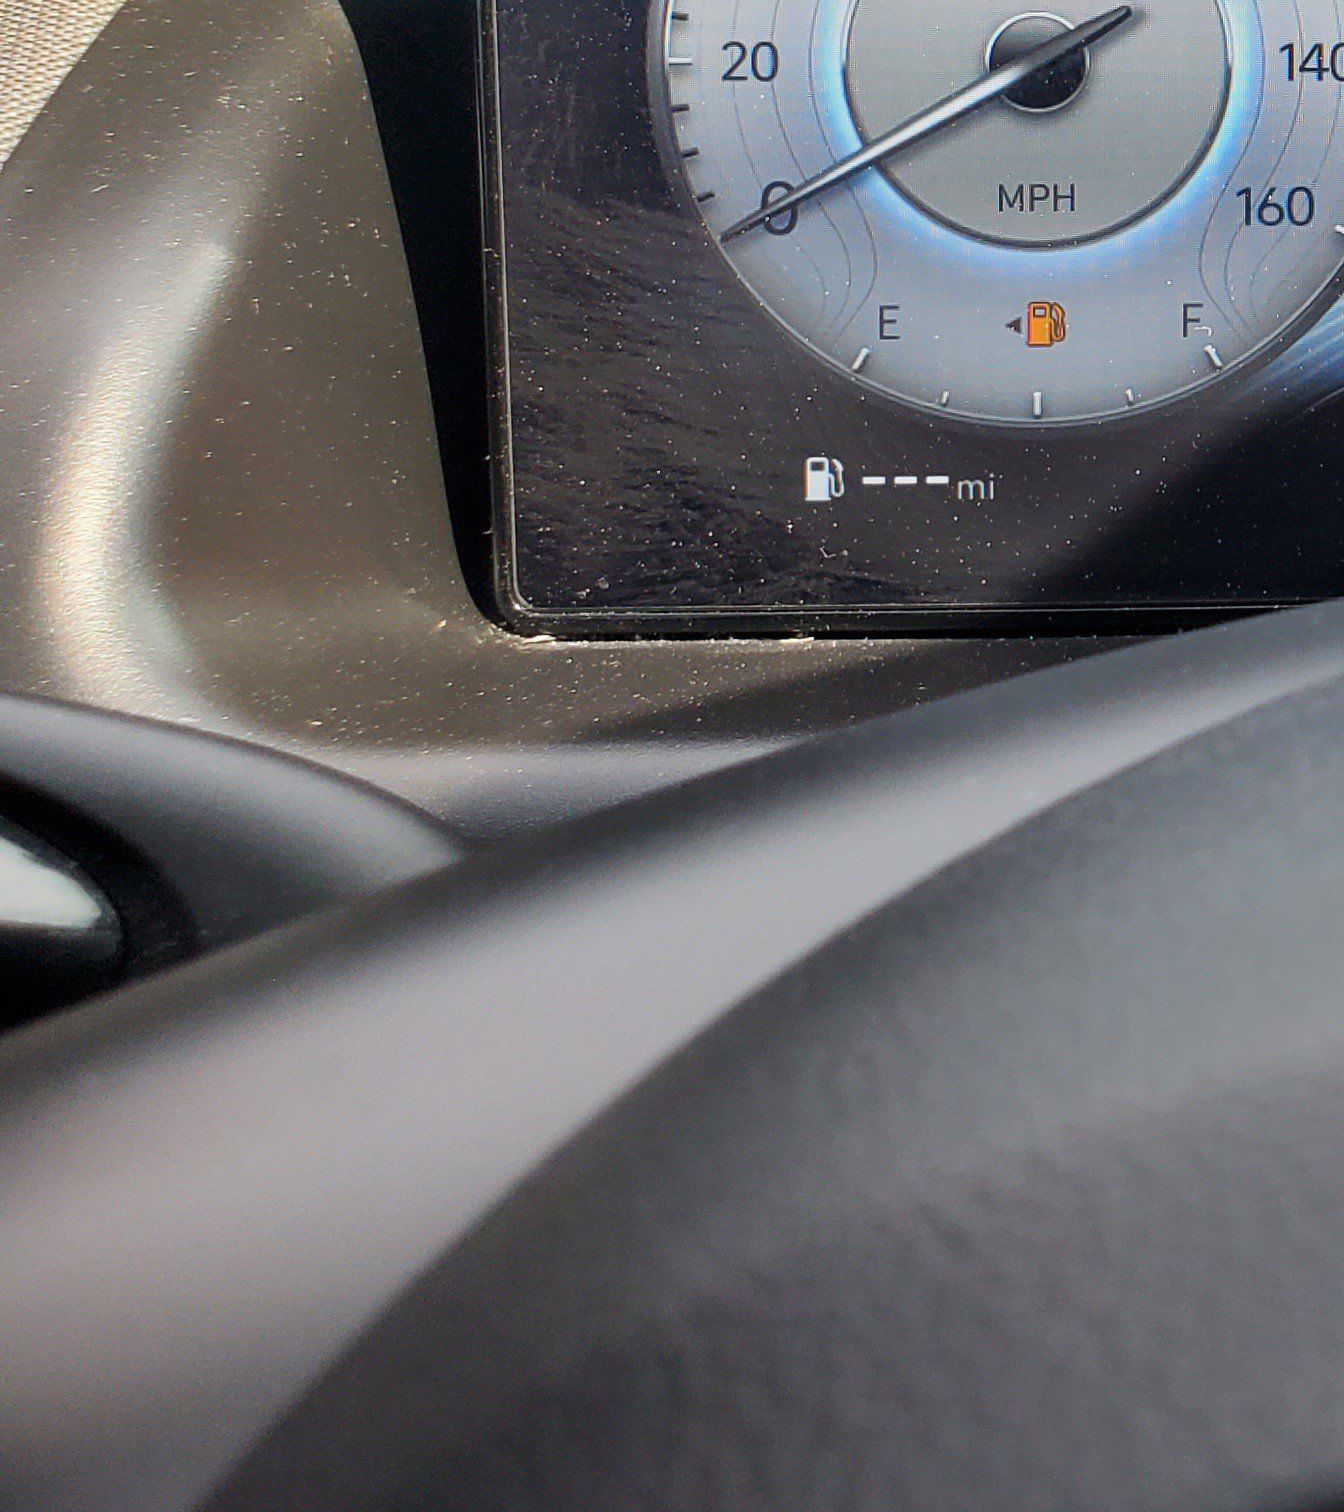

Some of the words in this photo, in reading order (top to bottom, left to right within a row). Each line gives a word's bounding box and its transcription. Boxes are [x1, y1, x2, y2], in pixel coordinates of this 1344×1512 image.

[720, 40, 779, 82] 20
[760, 179, 799, 236] 0
[997, 182, 1077, 213] MPH
[1236, 185, 1315, 228] 160
[878, 305, 902, 340] E
[1180, 302, 1204, 338] F
[956, 471, 996, 502] mi
